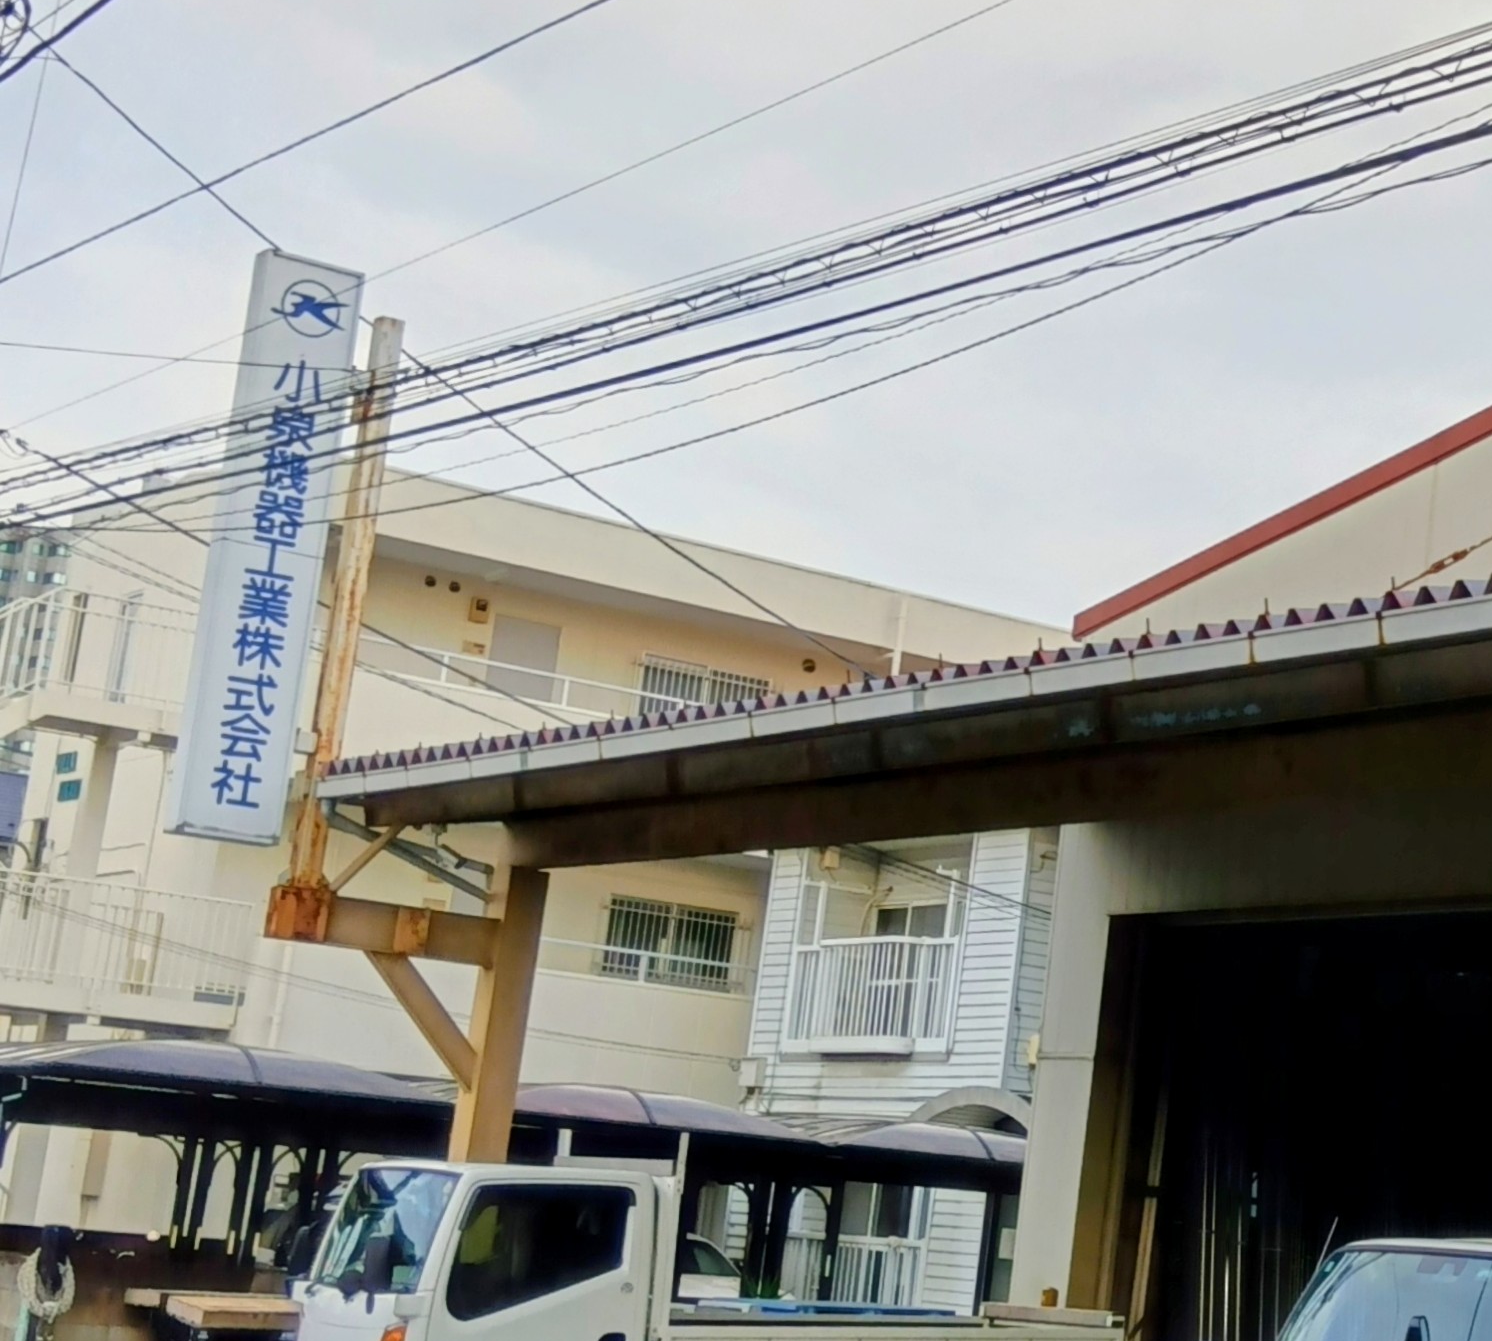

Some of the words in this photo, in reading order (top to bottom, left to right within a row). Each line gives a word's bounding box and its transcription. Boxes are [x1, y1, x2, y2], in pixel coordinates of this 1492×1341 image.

[212, 360, 321, 809] 小泉機器工業株式会社
